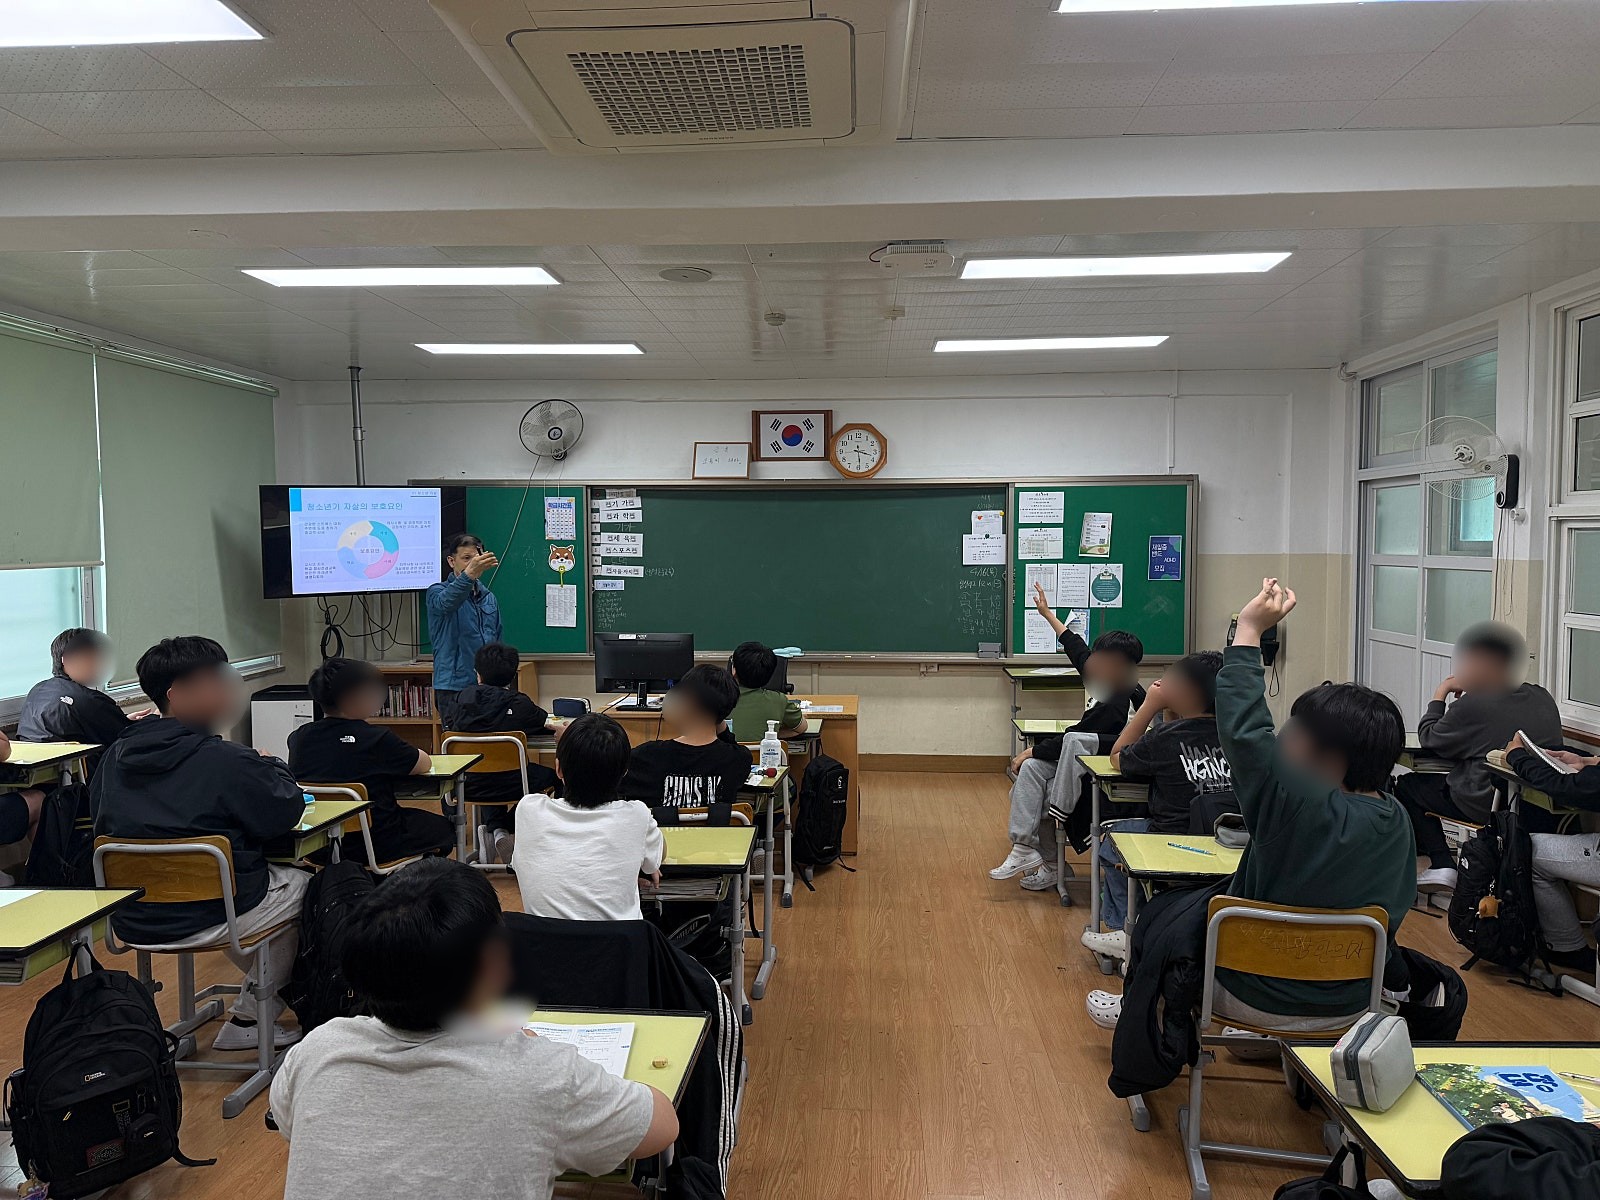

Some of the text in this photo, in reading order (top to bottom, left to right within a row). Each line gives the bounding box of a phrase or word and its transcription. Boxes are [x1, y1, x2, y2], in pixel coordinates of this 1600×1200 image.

[306, 501, 403, 511] 청소년기 자살의 보호요인
[1153, 564, 1165, 572] 모집
